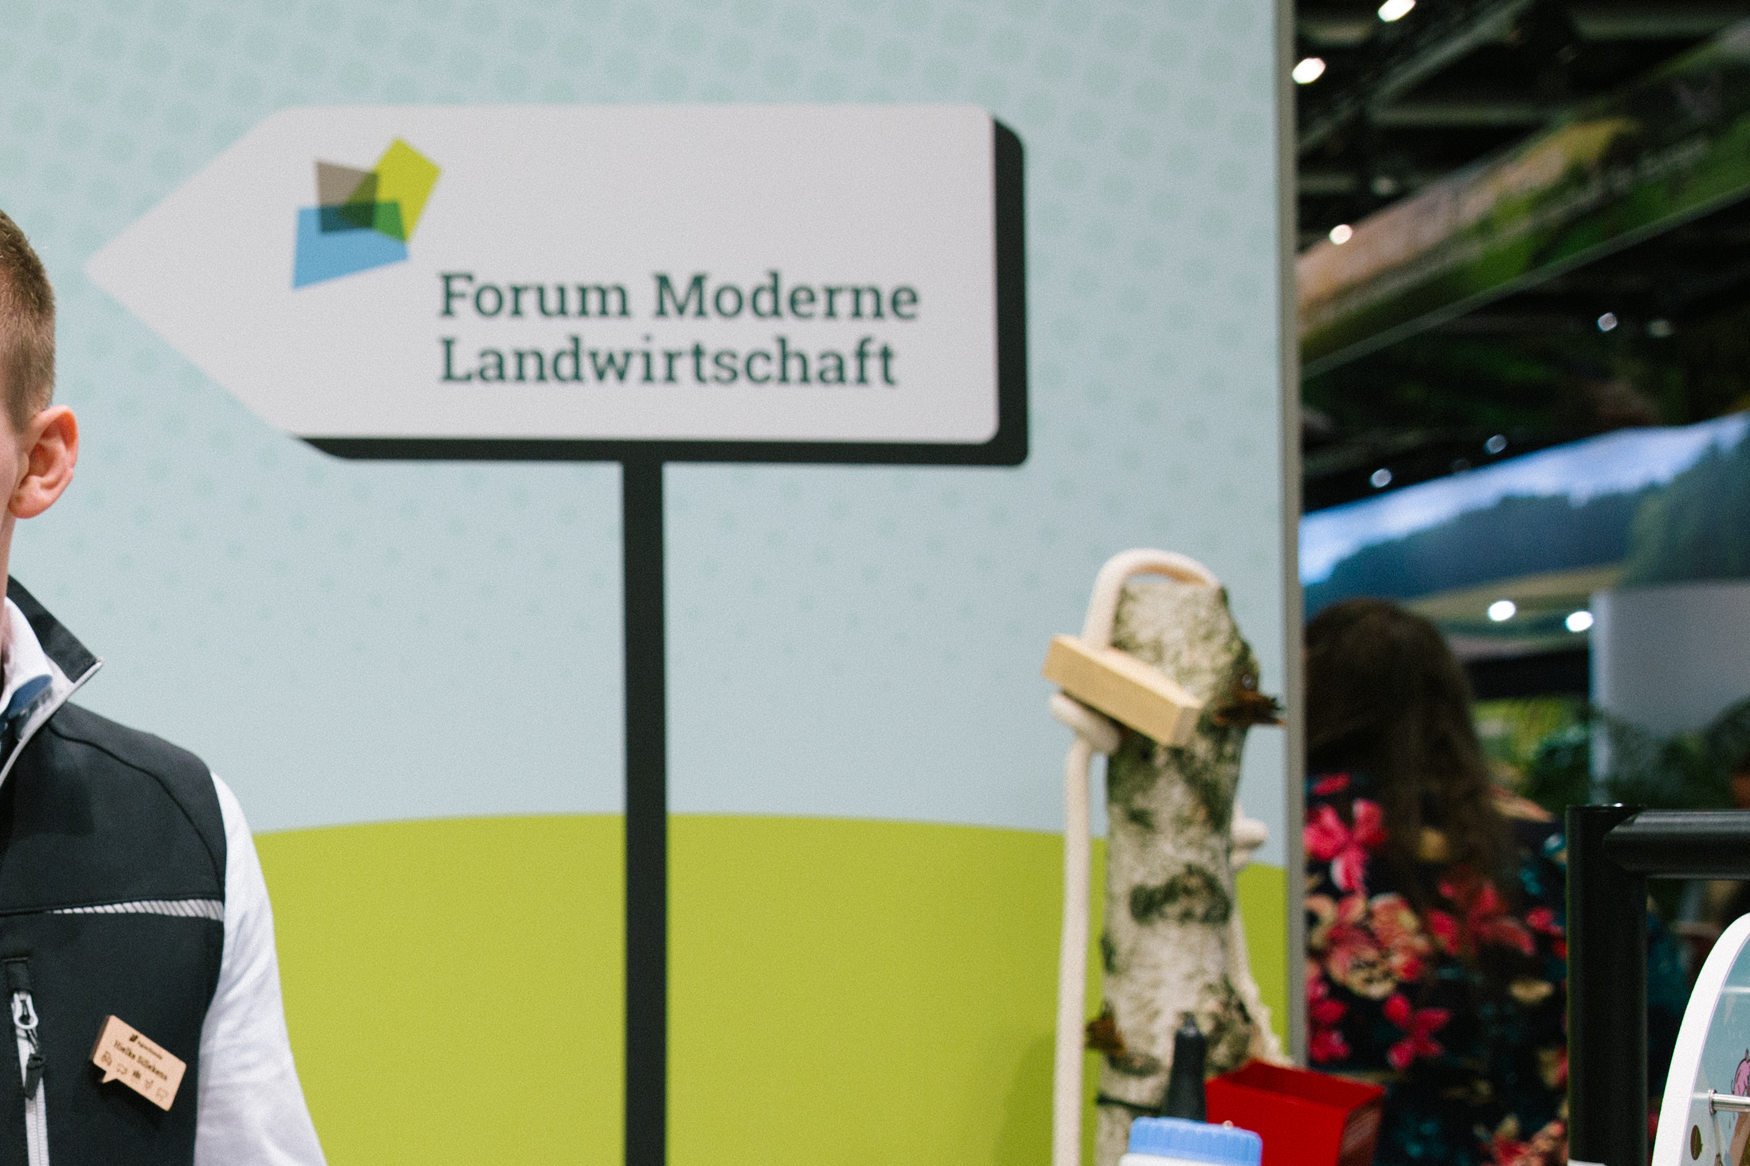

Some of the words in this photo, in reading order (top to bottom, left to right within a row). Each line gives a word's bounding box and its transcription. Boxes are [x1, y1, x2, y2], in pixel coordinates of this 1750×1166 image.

[438, 270, 633, 320] Forum
[652, 270, 921, 321] Moderne
[438, 334, 900, 388] Landwirtschaft
